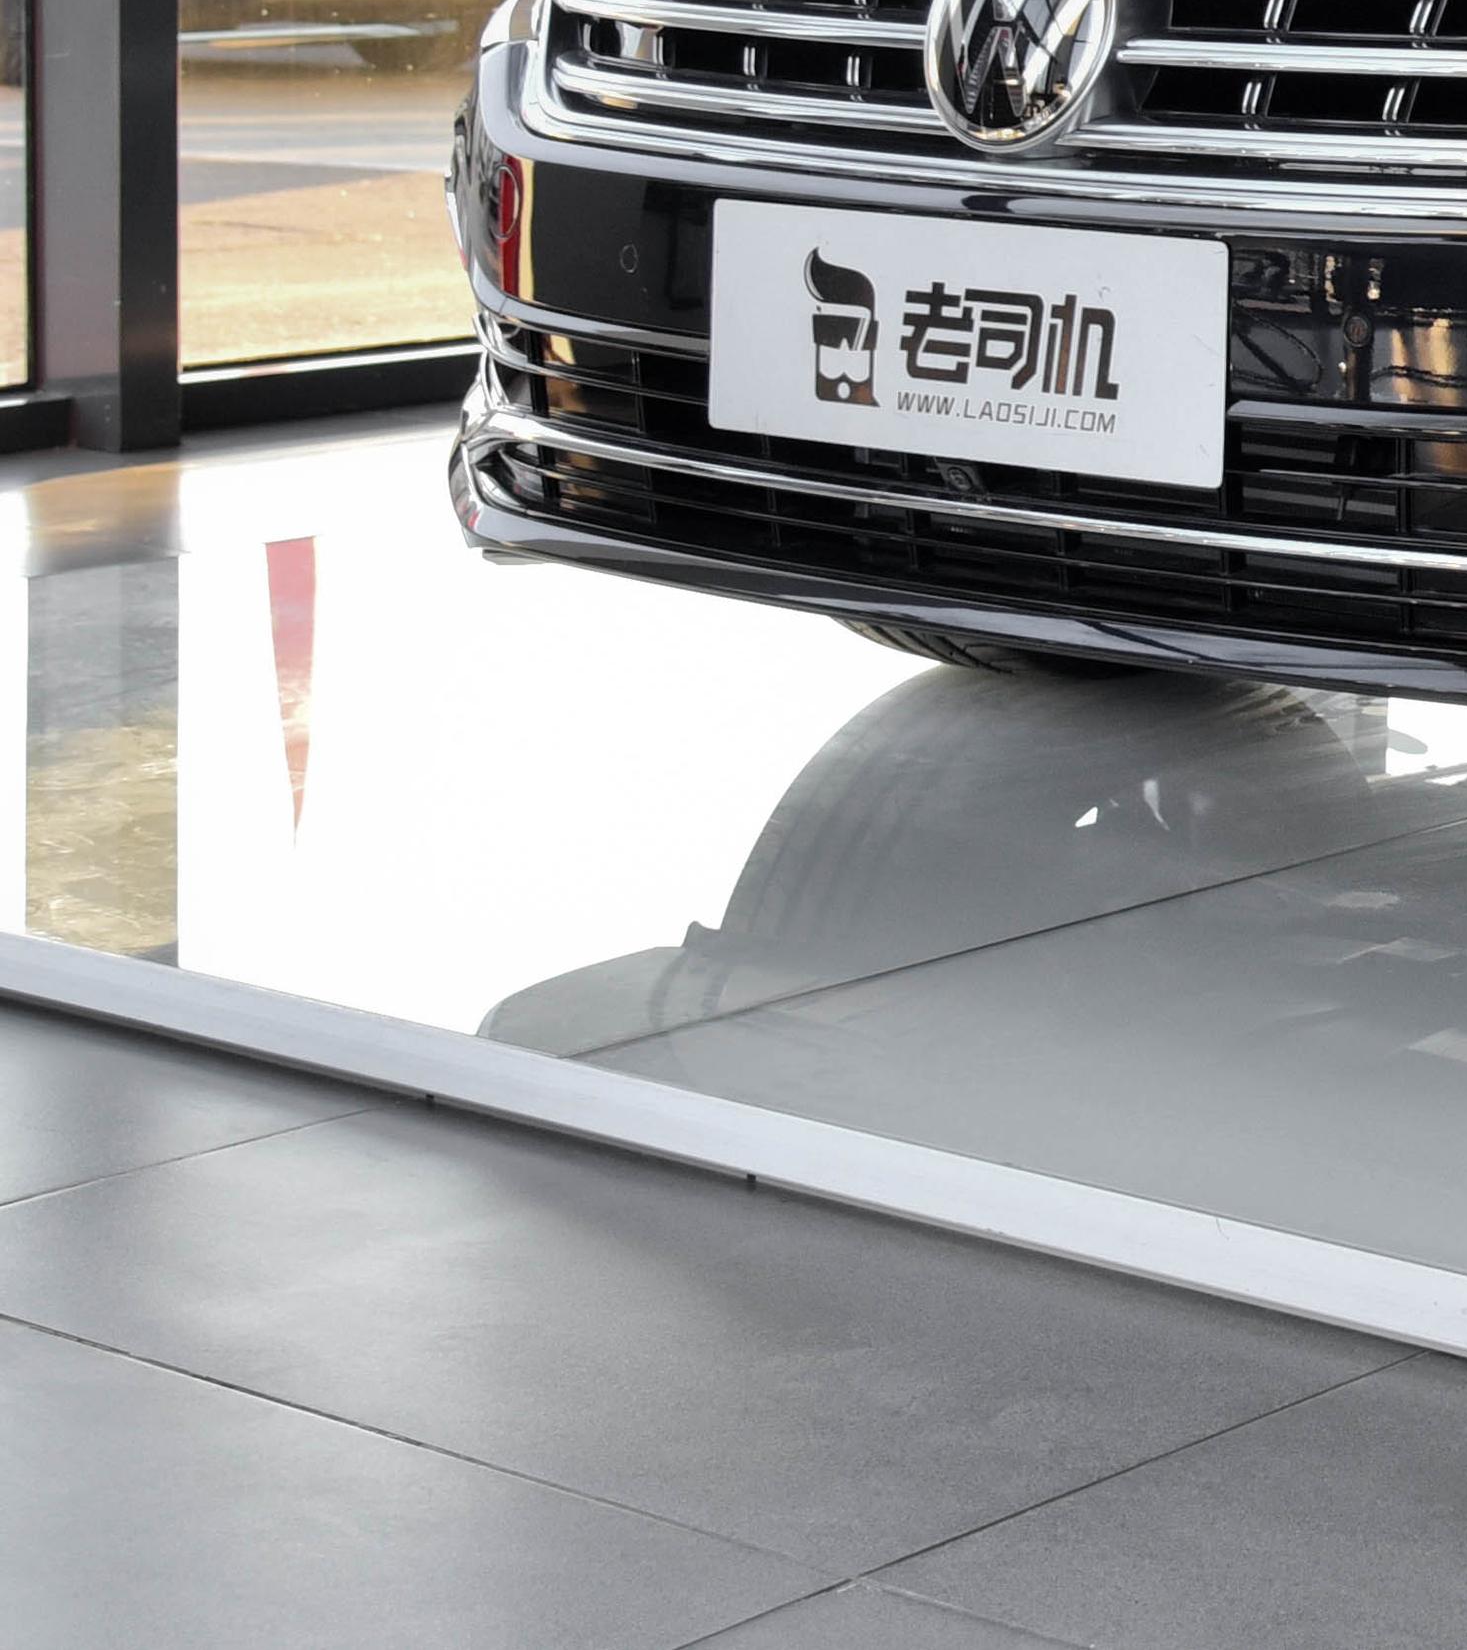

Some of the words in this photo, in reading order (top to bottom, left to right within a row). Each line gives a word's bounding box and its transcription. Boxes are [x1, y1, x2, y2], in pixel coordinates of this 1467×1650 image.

[900, 281, 1119, 400] 老司机
[897, 391, 1116, 434] WWW.LAOSIJI.COM
